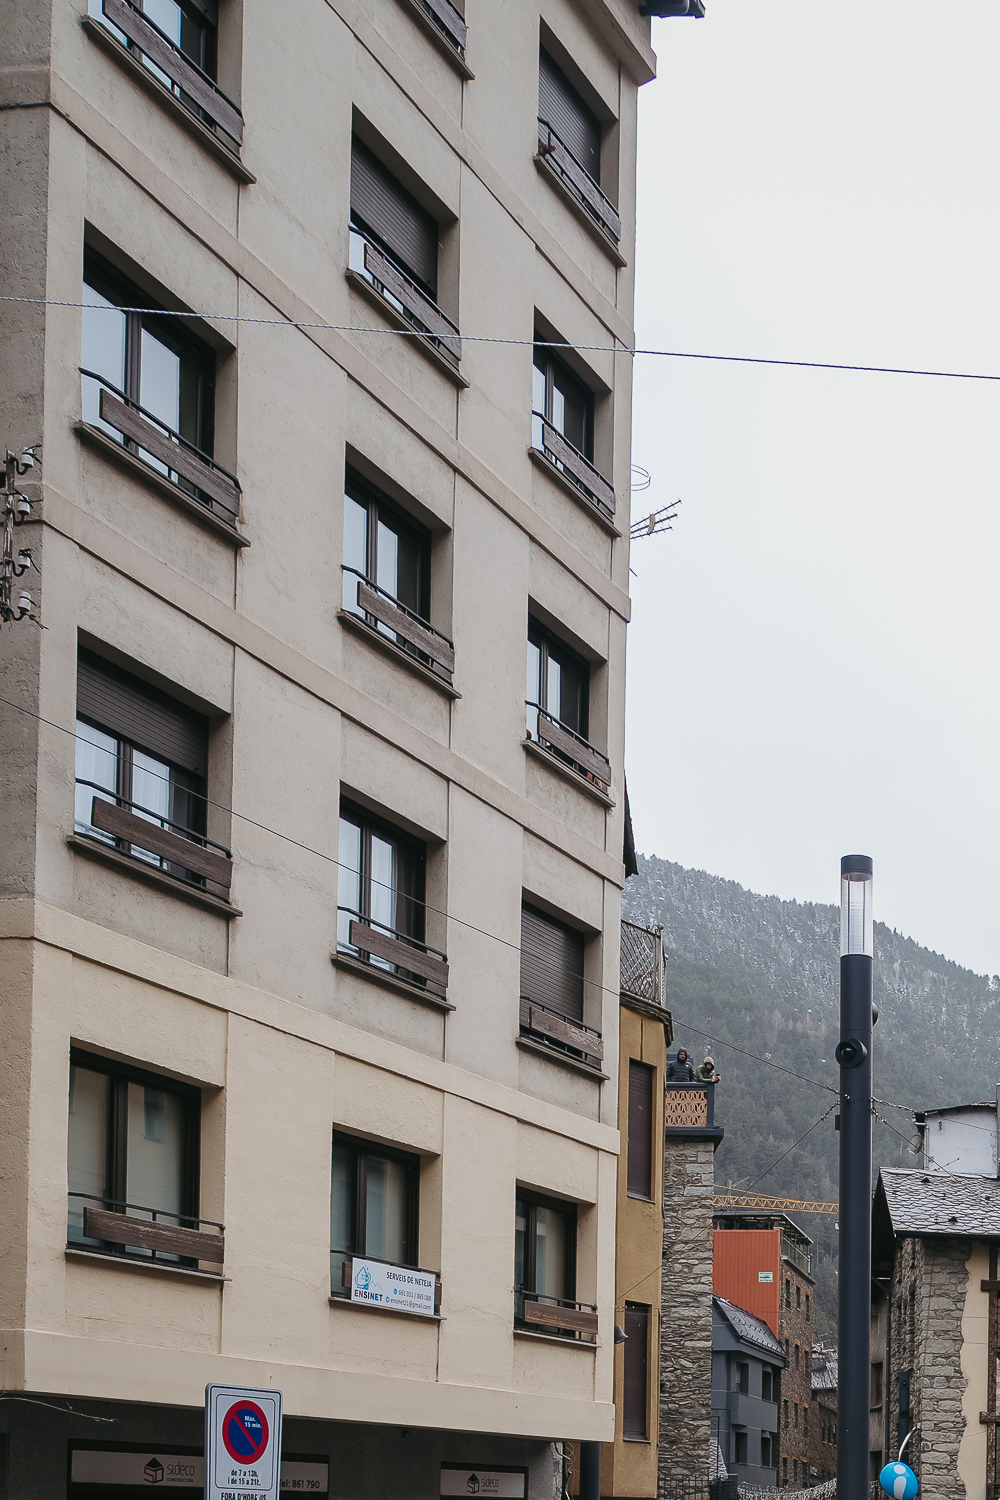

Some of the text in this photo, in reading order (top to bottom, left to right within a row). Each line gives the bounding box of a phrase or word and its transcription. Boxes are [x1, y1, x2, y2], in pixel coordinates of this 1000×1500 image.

[386, 1271, 432, 1288] SERVEIS DE NETEJA
[354, 1289, 383, 1302] ENSINET
[166, 1461, 195, 1476] sideco
[231, 1468, 237, 1476] de
[231, 1477, 237, 1485] de
[238, 1477, 245, 1485] 15
[292, 1480, 304, 1488] 861
[306, 1480, 320, 1489] 790
[481, 1476, 499, 1488] sideco
[221, 1492, 236, 1500] FORA
